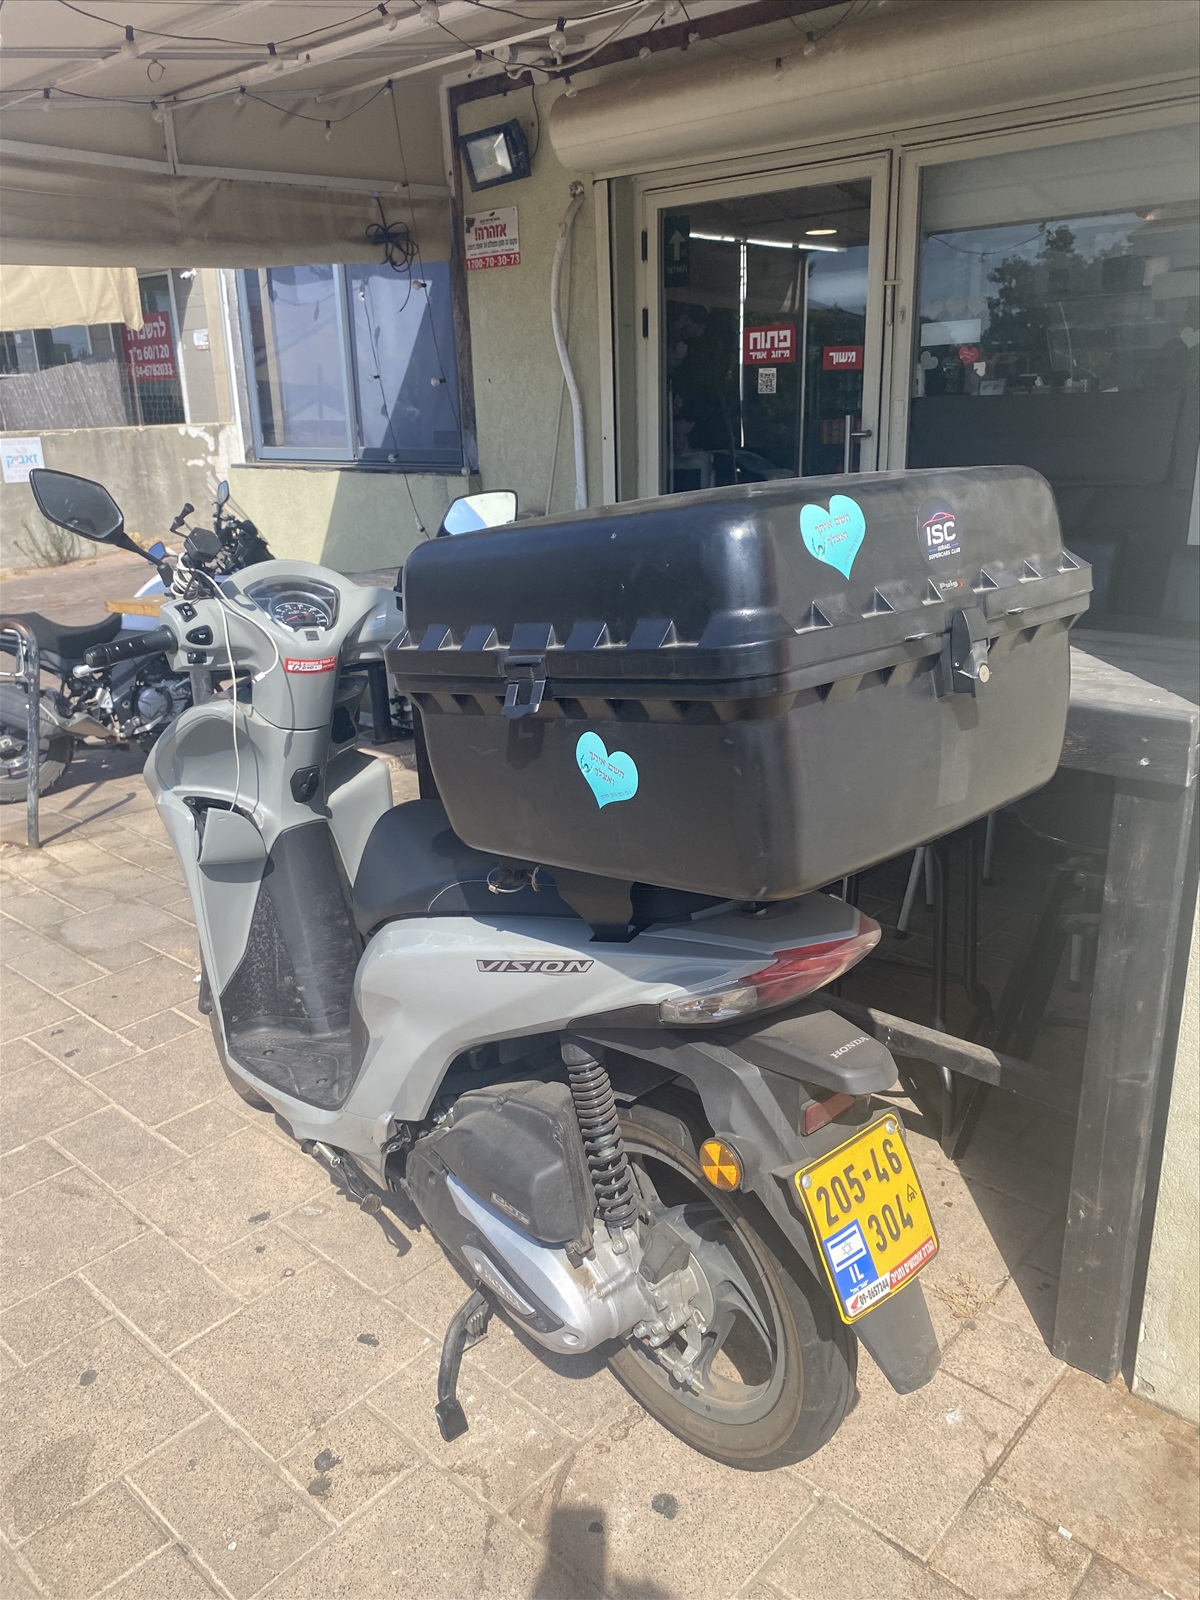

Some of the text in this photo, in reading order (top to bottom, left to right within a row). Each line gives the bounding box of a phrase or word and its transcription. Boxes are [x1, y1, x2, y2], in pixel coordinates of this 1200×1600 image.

[474, 224, 506, 241] אזהרה!
[467, 253, 520, 269] 1700-70-30-73
[749, 329, 791, 350] פתוח
[143, 343, 170, 361] 60/120
[770, 349, 791, 358] מיזוג
[829, 351, 856, 365] משוך
[815, 513, 851, 535] השם איתך
[827, 531, 849, 547] ואצלך
[926, 521, 956, 546] ISC
[928, 547, 961, 561] SUPERCARS CLUB
[937, 543, 952, 552] ISRAEL
[939, 579, 958, 590] Puig
[589, 751, 625, 779] השם איתך
[594, 767, 615, 786] ואצלך
[477, 960, 594, 972] VISION
[830, 1036, 870, 1059] HONDA
[816, 1138, 903, 1227] 205-46
[867, 1193, 914, 1252] 304
[849, 1263, 865, 1284] IL
[859, 1278, 889, 1305] 09-8657244
